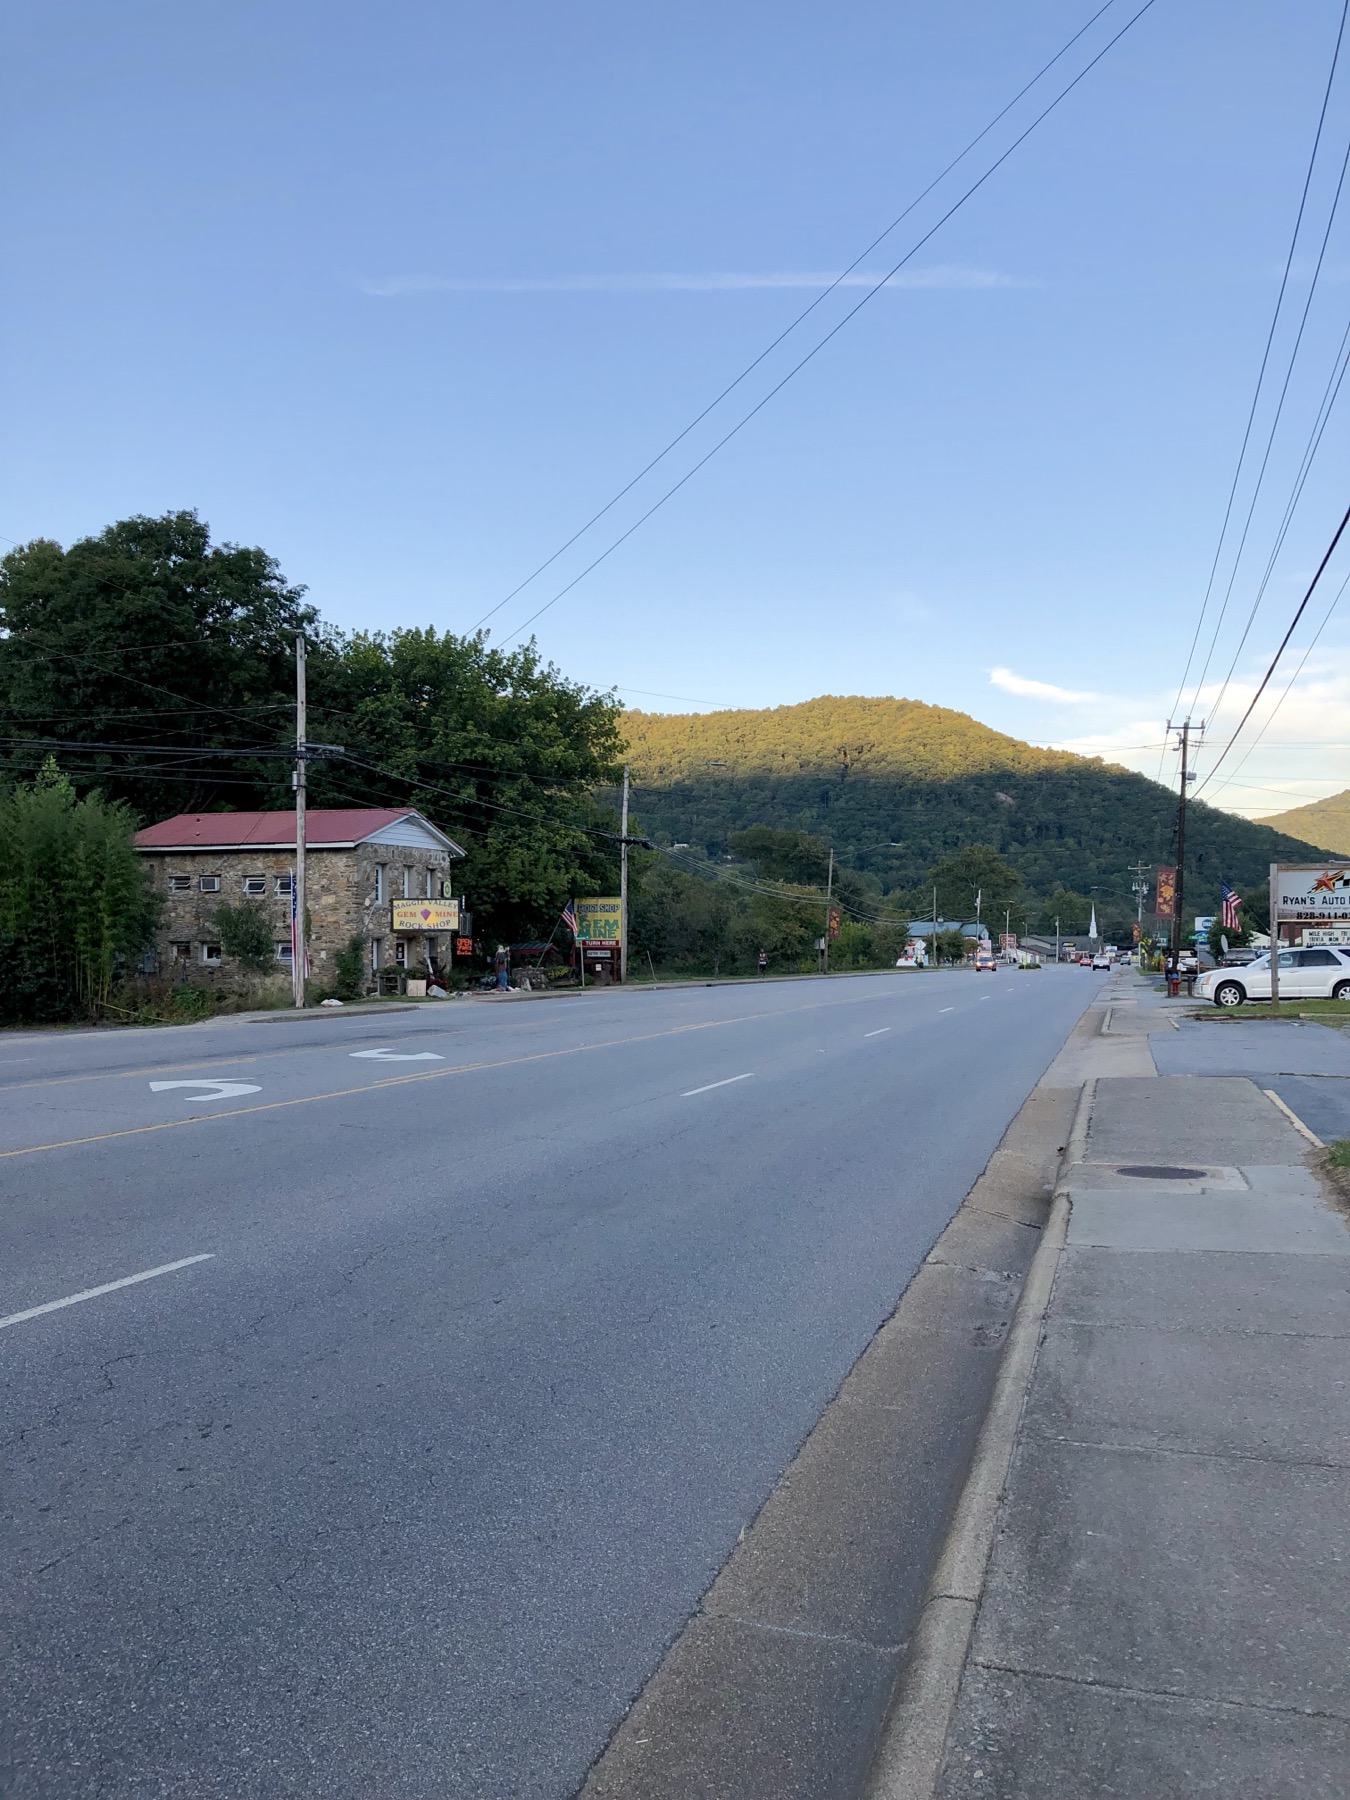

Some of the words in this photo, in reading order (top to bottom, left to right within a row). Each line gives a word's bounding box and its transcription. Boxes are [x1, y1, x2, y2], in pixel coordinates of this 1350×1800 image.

[393, 899, 425, 910] MAGGIE
[428, 899, 458, 909] VALLEY
[1282, 895, 1315, 905] RYAN'S
[1321, 895, 1346, 905] AUTO
[599, 903, 620, 913] SHOP
[399, 920, 423, 930] ROCK
[427, 919, 451, 930] SHOP
[579, 918, 620, 930] GEM
[577, 929, 617, 939] MINE
